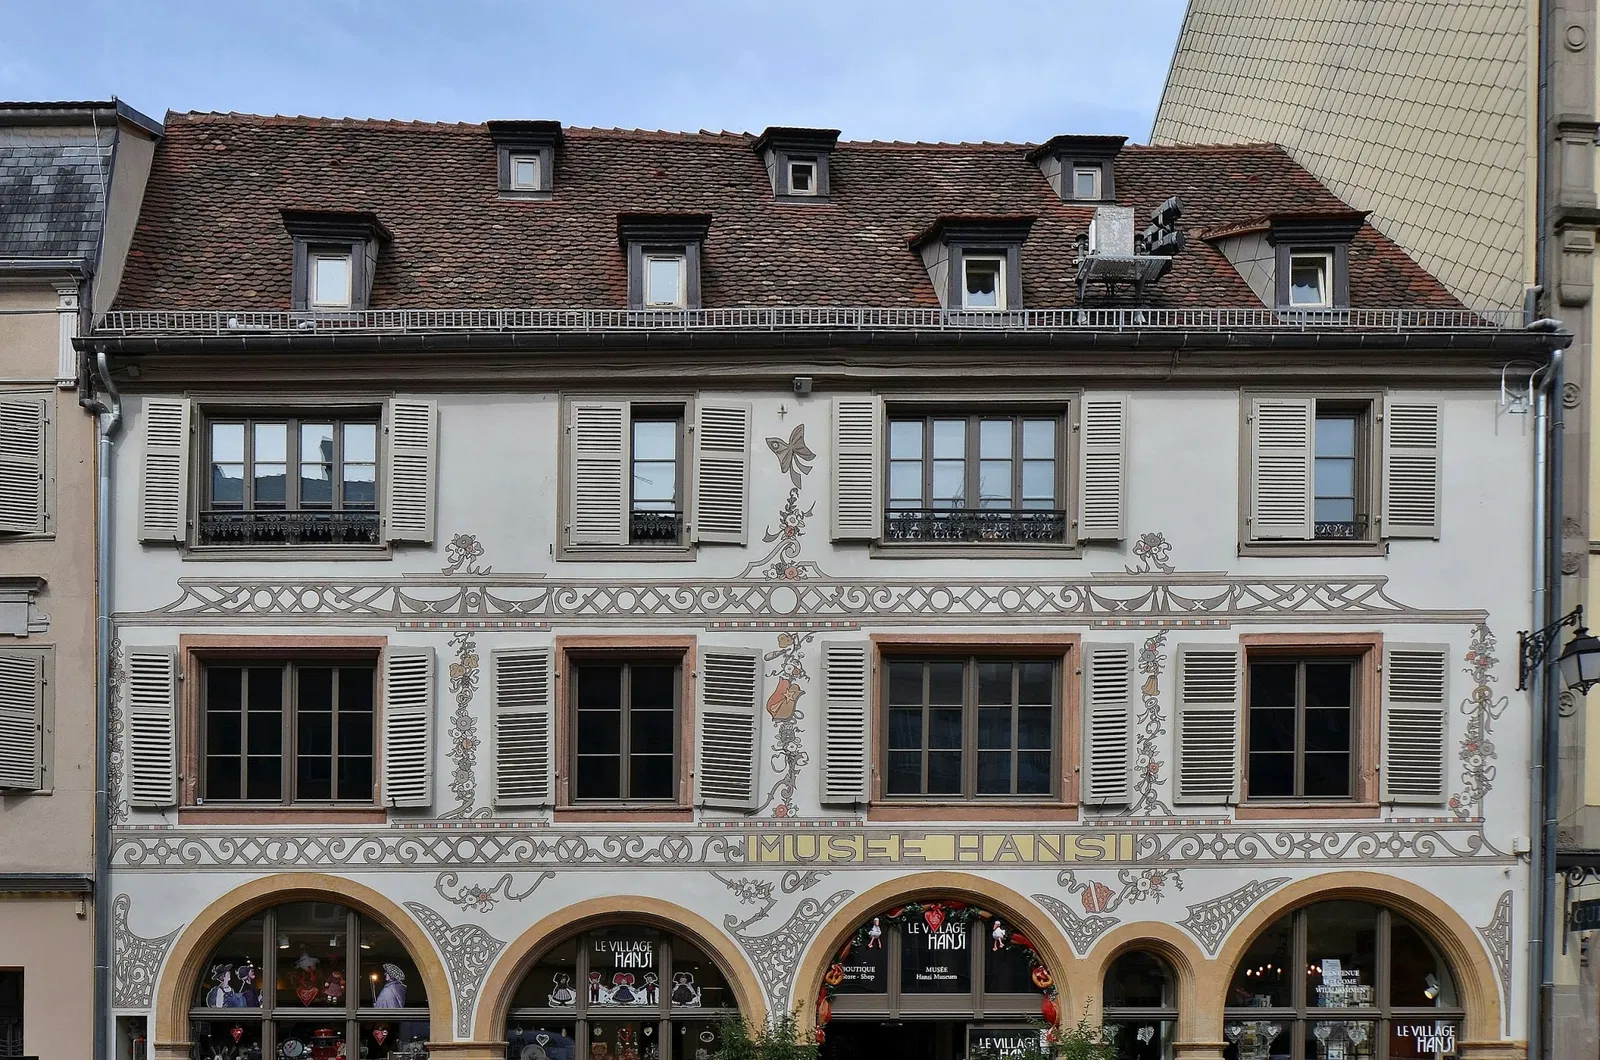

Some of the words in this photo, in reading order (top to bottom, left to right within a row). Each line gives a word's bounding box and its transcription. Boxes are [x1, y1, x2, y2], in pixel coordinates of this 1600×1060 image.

[756, 833, 927, 863] MUSEE
[954, 833, 1121, 863] HANSI
[908, 922, 920, 934] LE
[921, 922, 966, 934] VLAGE
[595, 940, 607, 952] LE
[608, 940, 652, 952] VILLAGE
[928, 933, 966, 950] HANSI
[615, 951, 653, 968] HANSI
[860, 973, 875, 981] Shop
[1397, 1025, 1409, 1037] LE
[1410, 1025, 1456, 1037] VILLAGE
[979, 1037, 991, 1049] LE
[1417, 1036, 1456, 1053] HANSI
